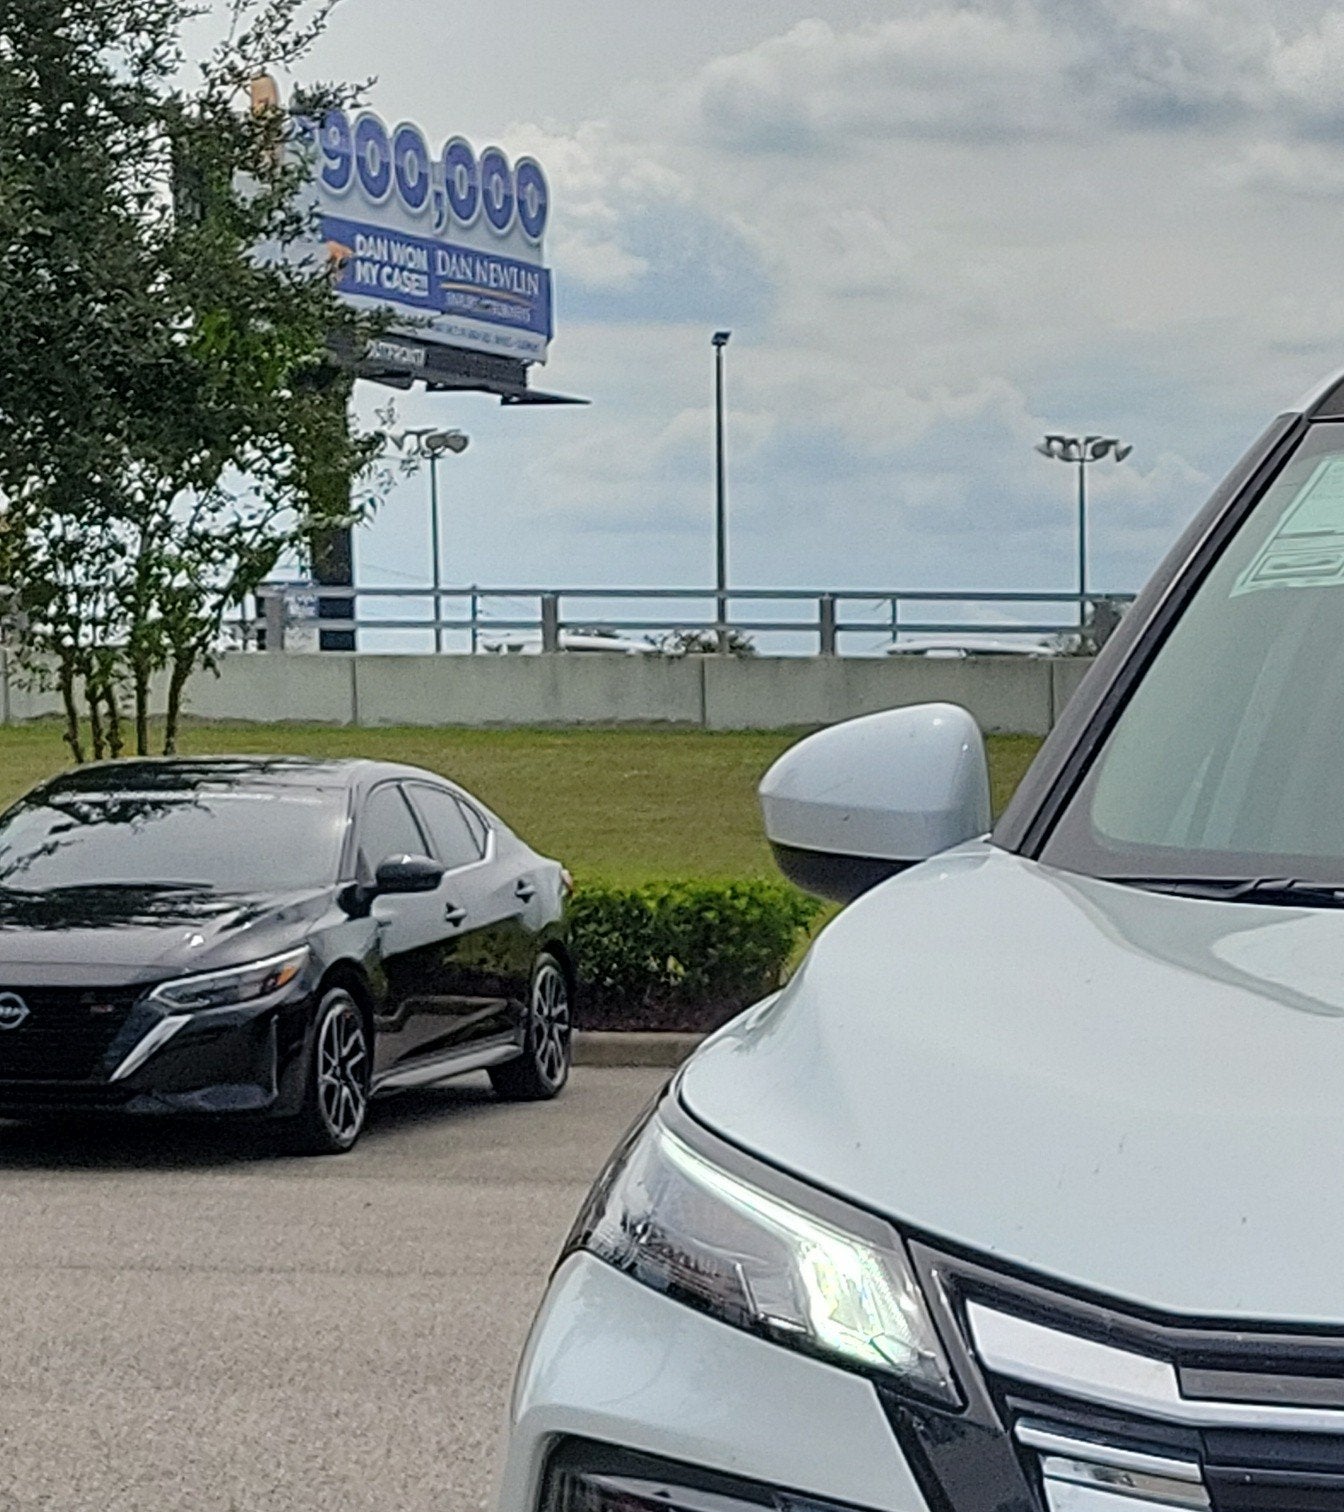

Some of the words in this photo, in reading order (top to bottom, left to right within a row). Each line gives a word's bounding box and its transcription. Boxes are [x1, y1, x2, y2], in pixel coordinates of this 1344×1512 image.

[292, 109, 548, 239] 900,000
[355, 234, 388, 262] DAN
[390, 241, 428, 271] WON
[355, 260, 379, 286] MY
[436, 250, 472, 281] DAN
[476, 258, 539, 295] NEWLIN
